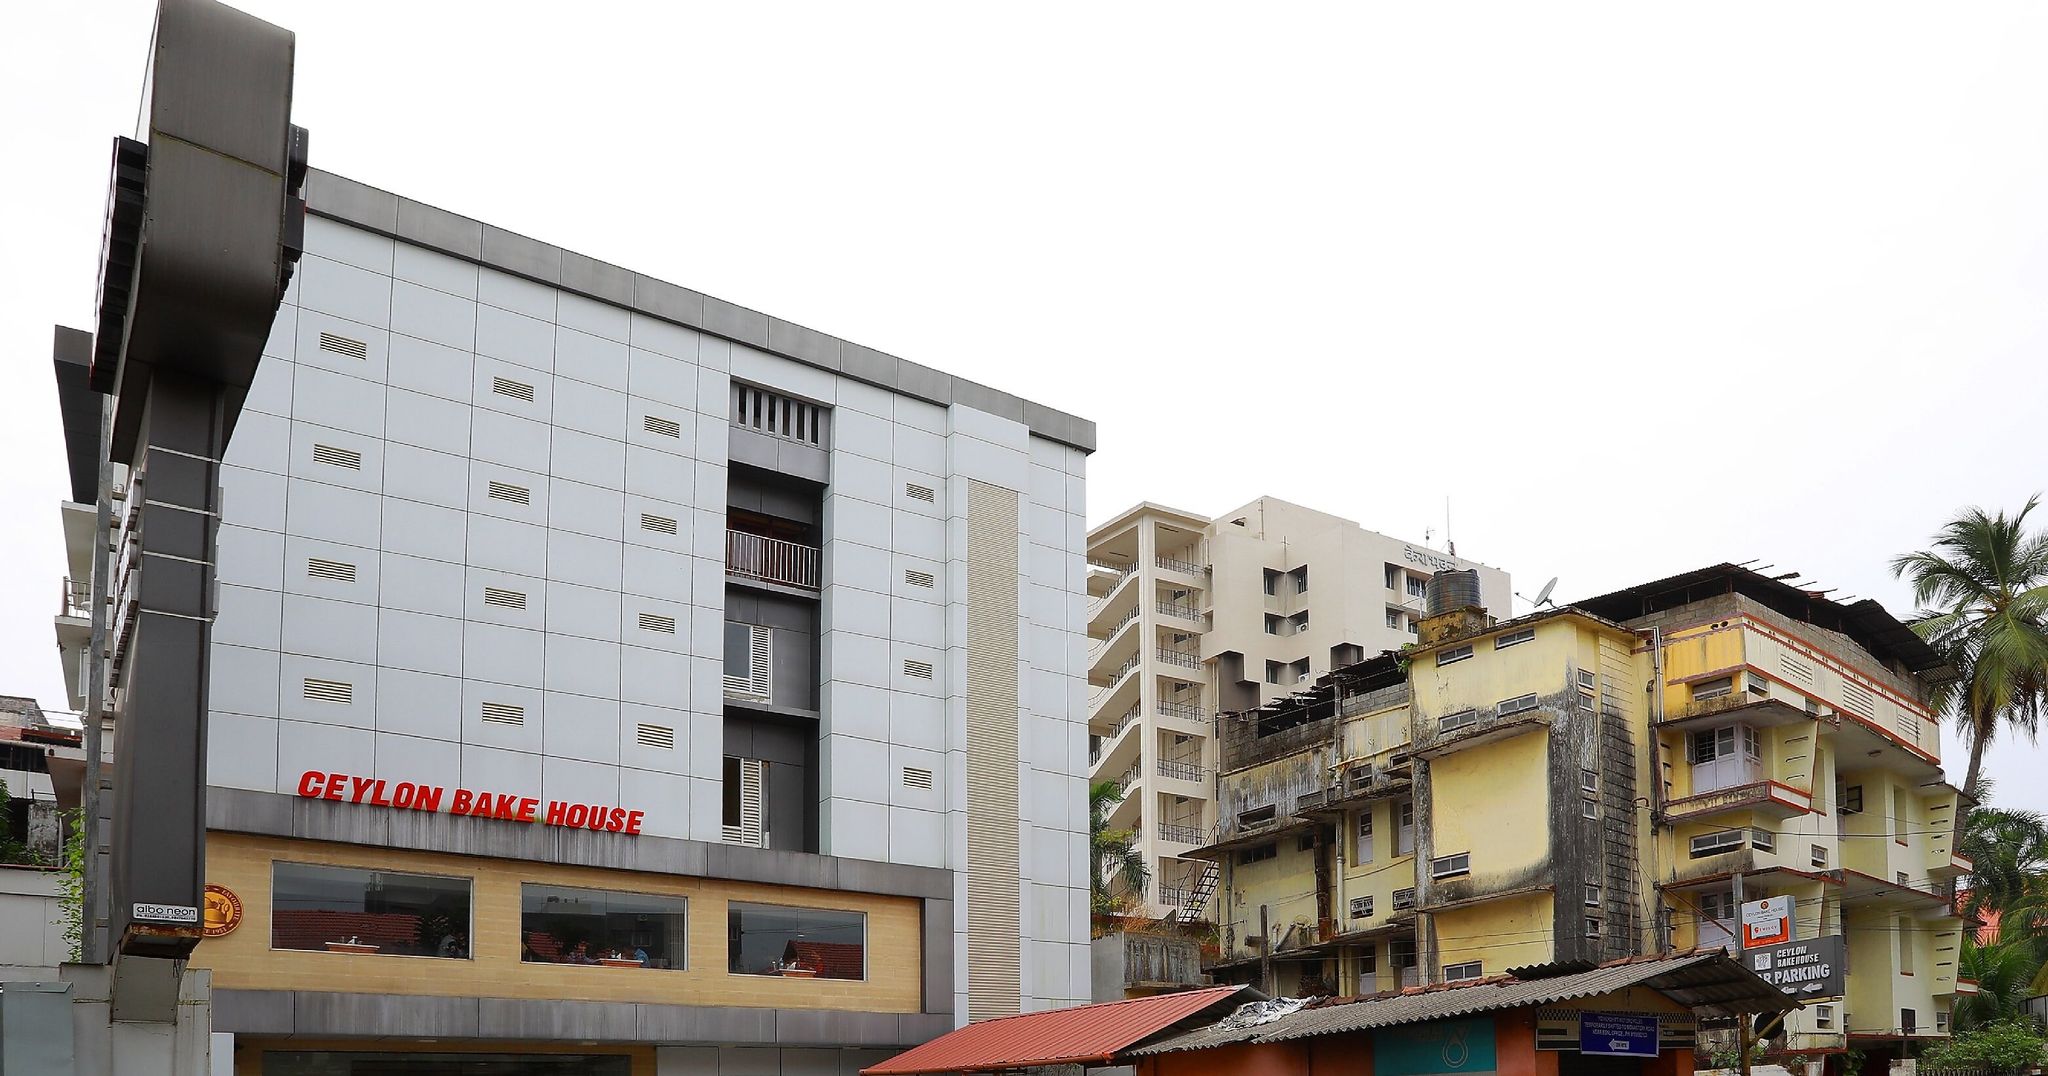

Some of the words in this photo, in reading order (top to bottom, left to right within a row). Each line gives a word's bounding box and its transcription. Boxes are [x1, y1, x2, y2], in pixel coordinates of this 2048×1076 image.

[298, 770, 444, 813] CEYLON
[450, 788, 540, 824] BAKE
[545, 801, 645, 835] HOUSE
[136, 905, 164, 914] albo
[166, 907, 196, 916] neon
[1777, 946, 1807, 957] CEYLON
[1774, 964, 1830, 984] PARKING
